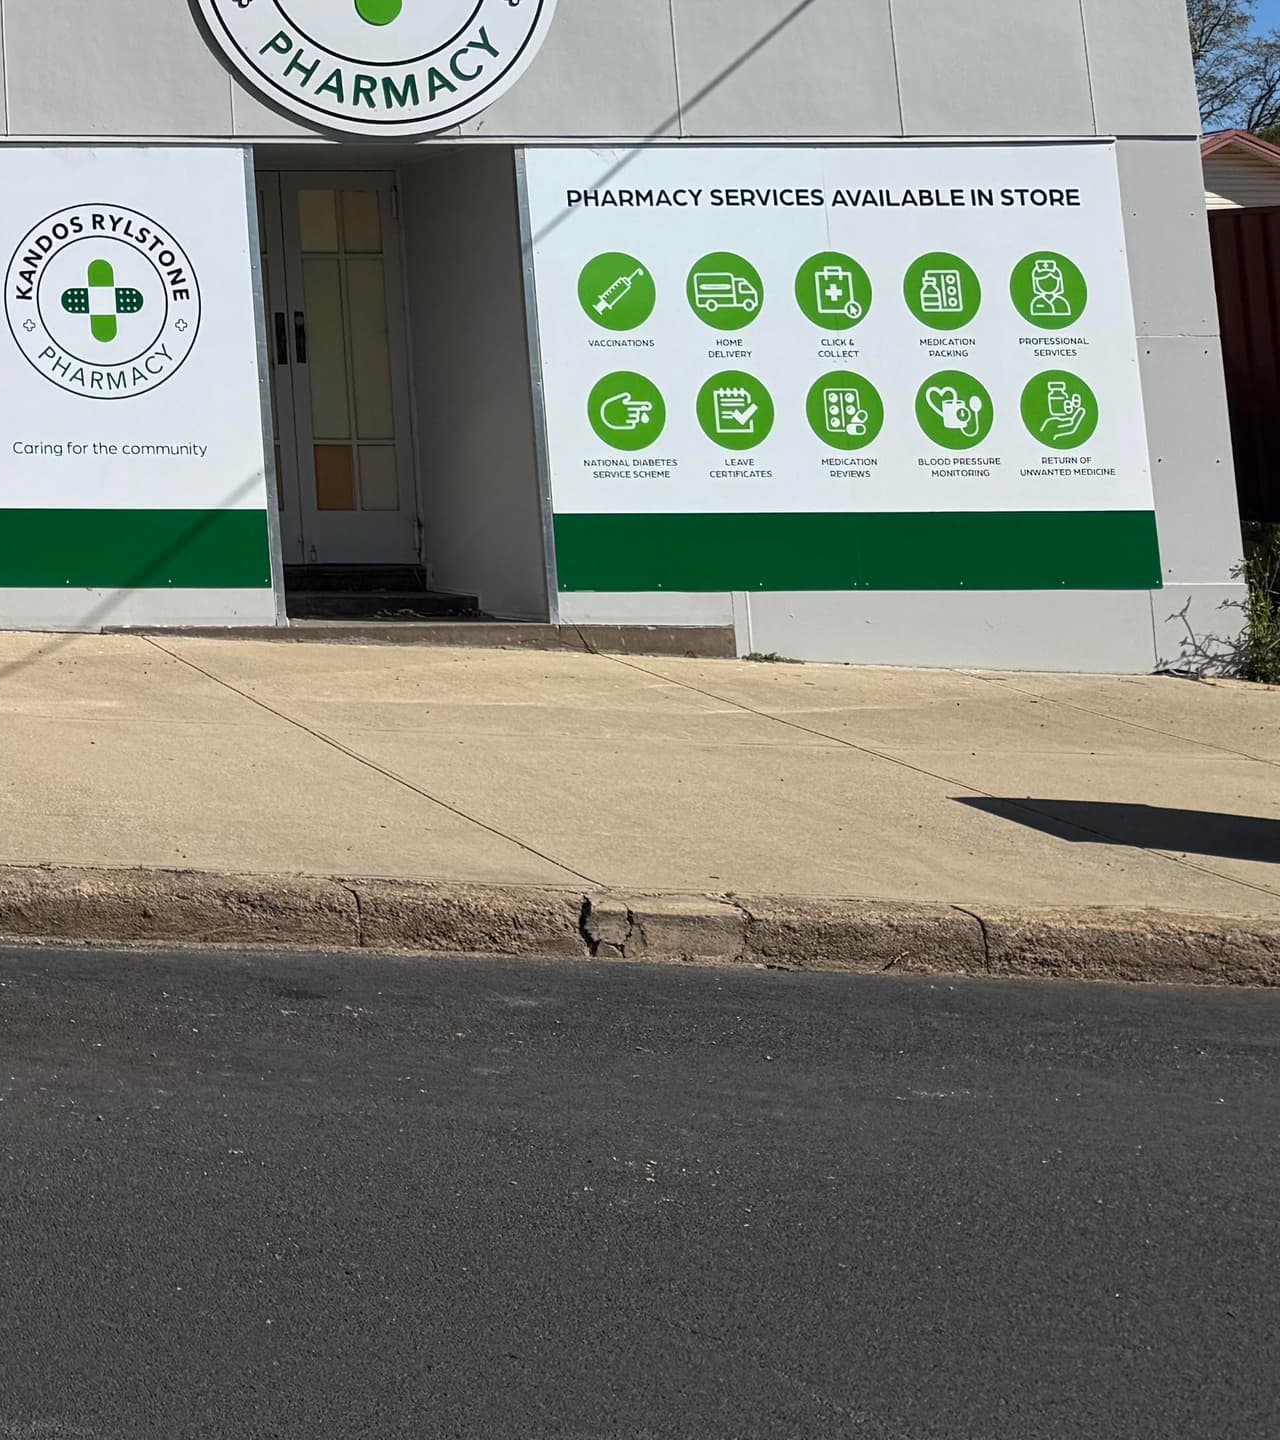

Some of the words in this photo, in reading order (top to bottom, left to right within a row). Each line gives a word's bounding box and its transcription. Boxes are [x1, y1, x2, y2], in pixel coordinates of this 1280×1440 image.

[258, 26, 500, 109] PHARMACY
[567, 188, 703, 208] PHARMACY
[710, 188, 825, 208] SERVICES
[832, 188, 968, 208] AVAILABLE
[971, 188, 995, 208] IN
[1001, 188, 1081, 208] STORE
[15, 215, 84, 301] KANDOS
[92, 213, 190, 302] RYLSTONE
[587, 339, 655, 348] VACCINATIONS
[715, 338, 743, 347] HOME
[820, 338, 847, 347] CLICK
[848, 338, 855, 347] &
[919, 338, 976, 347] MEDICATION
[1018, 337, 1090, 346] PROFESSIONAL
[707, 350, 753, 359] DELIVERY
[817, 350, 860, 359] COLLECT
[928, 349, 969, 358] PACKING
[1033, 348, 1078, 357] SERVICES
[37, 344, 173, 390] PHARMACY
[13, 442, 62, 456] Caring
[66, 441, 89, 455] for
[92, 441, 118, 455] the
[122, 442, 207, 457] community
[583, 458, 631, 468] NATIONAL
[632, 458, 679, 467] DIABETES
[724, 458, 755, 467] LEAVE
[821, 457, 878, 467] MEDICATION
[917, 457, 952, 466] BLOOD
[952, 457, 1001, 466] PRESSURE
[1041, 456, 1078, 465] RETURN
[1079, 456, 1092, 465] OF
[592, 470, 632, 479] SERVICE
[632, 470, 671, 479] SCHEME
[709, 470, 773, 479] CERTIFICATES
[829, 469, 872, 478] REVIEWS
[931, 468, 991, 478] MONITORING
[1019, 468, 1072, 477] UNWANTED
[1073, 467, 1117, 476] MEDICINE
